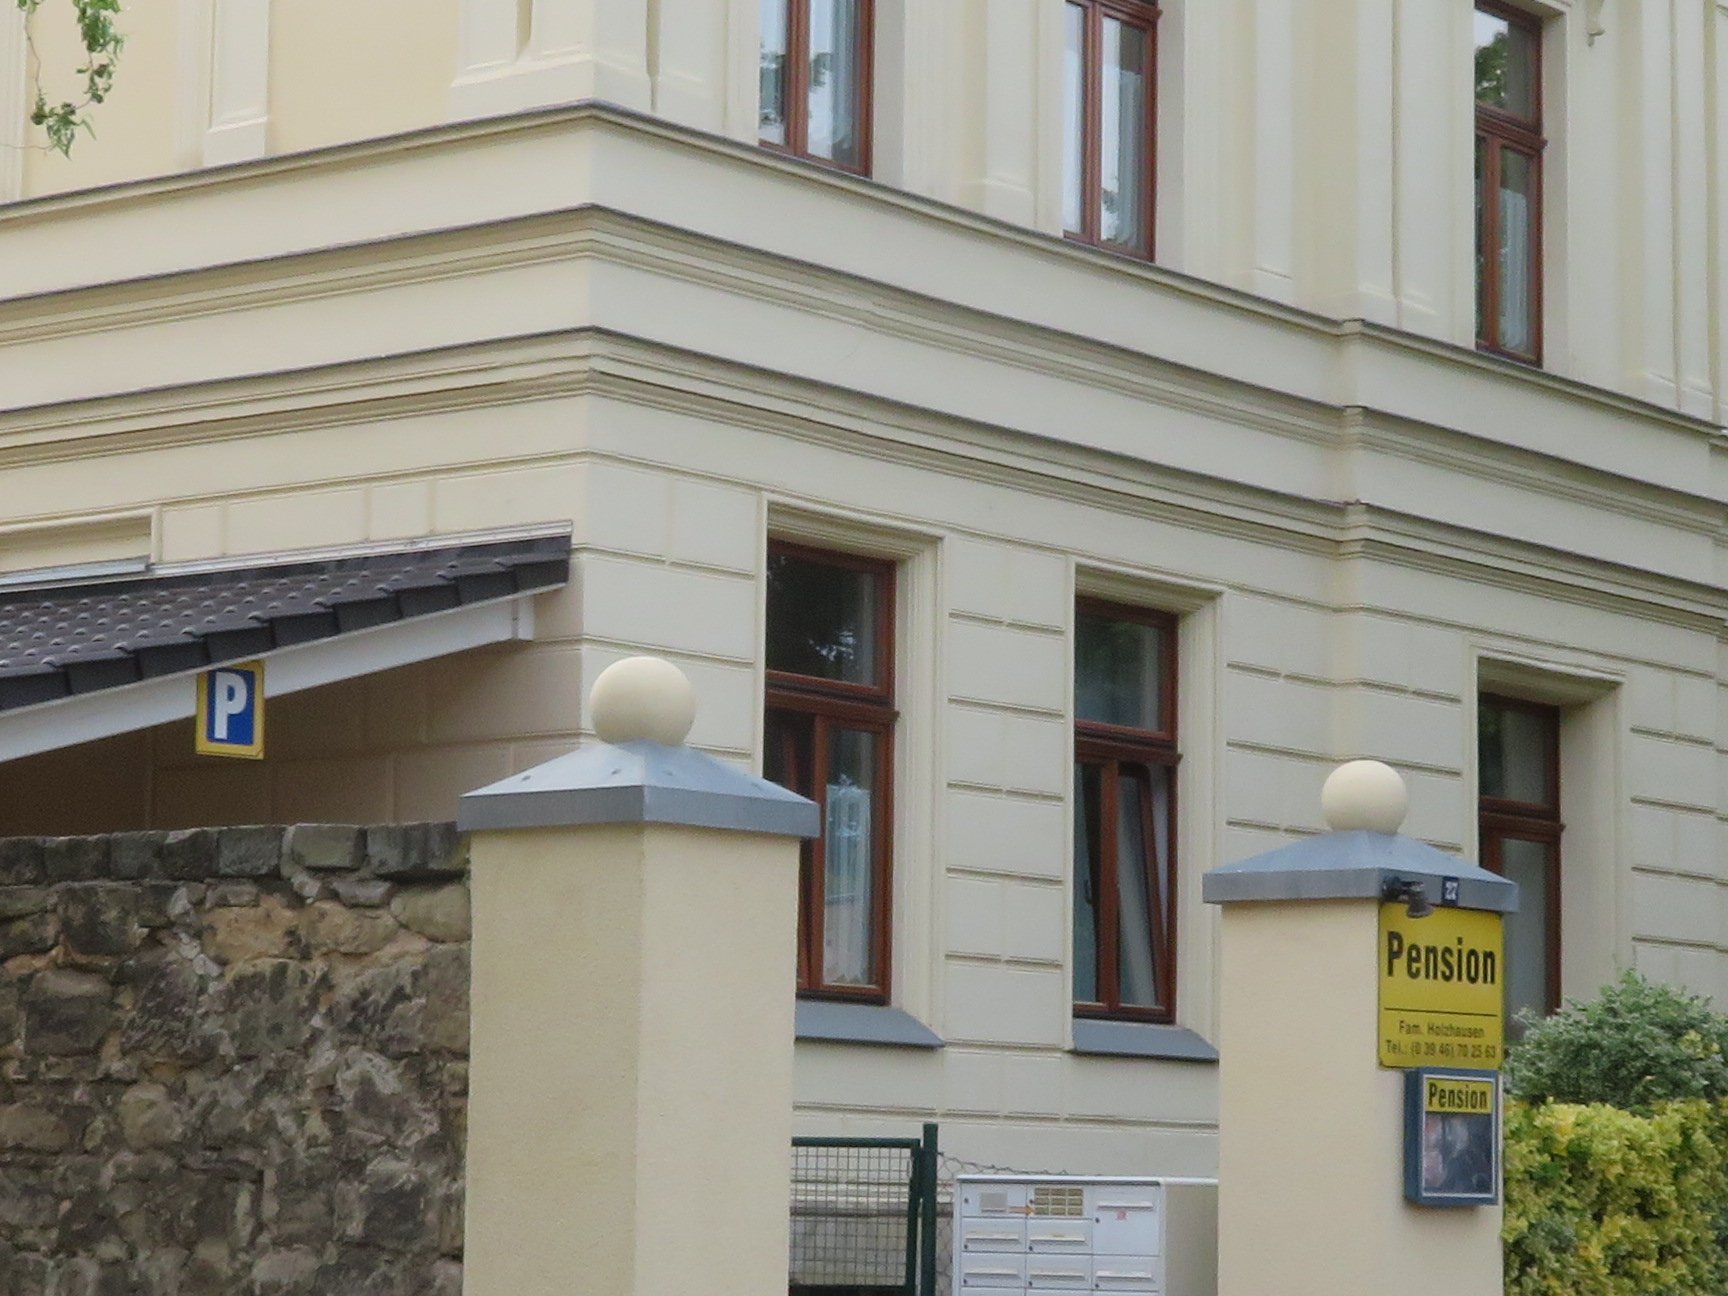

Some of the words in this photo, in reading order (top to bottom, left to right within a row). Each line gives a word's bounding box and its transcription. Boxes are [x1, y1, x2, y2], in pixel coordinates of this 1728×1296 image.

[214, 671, 248, 740] P
[1387, 931, 1495, 984] Pension
[1399, 1019, 1424, 1036] Fam.
[1427, 1022, 1485, 1039] Holzhausen
[1428, 1082, 1488, 1109] Pension
